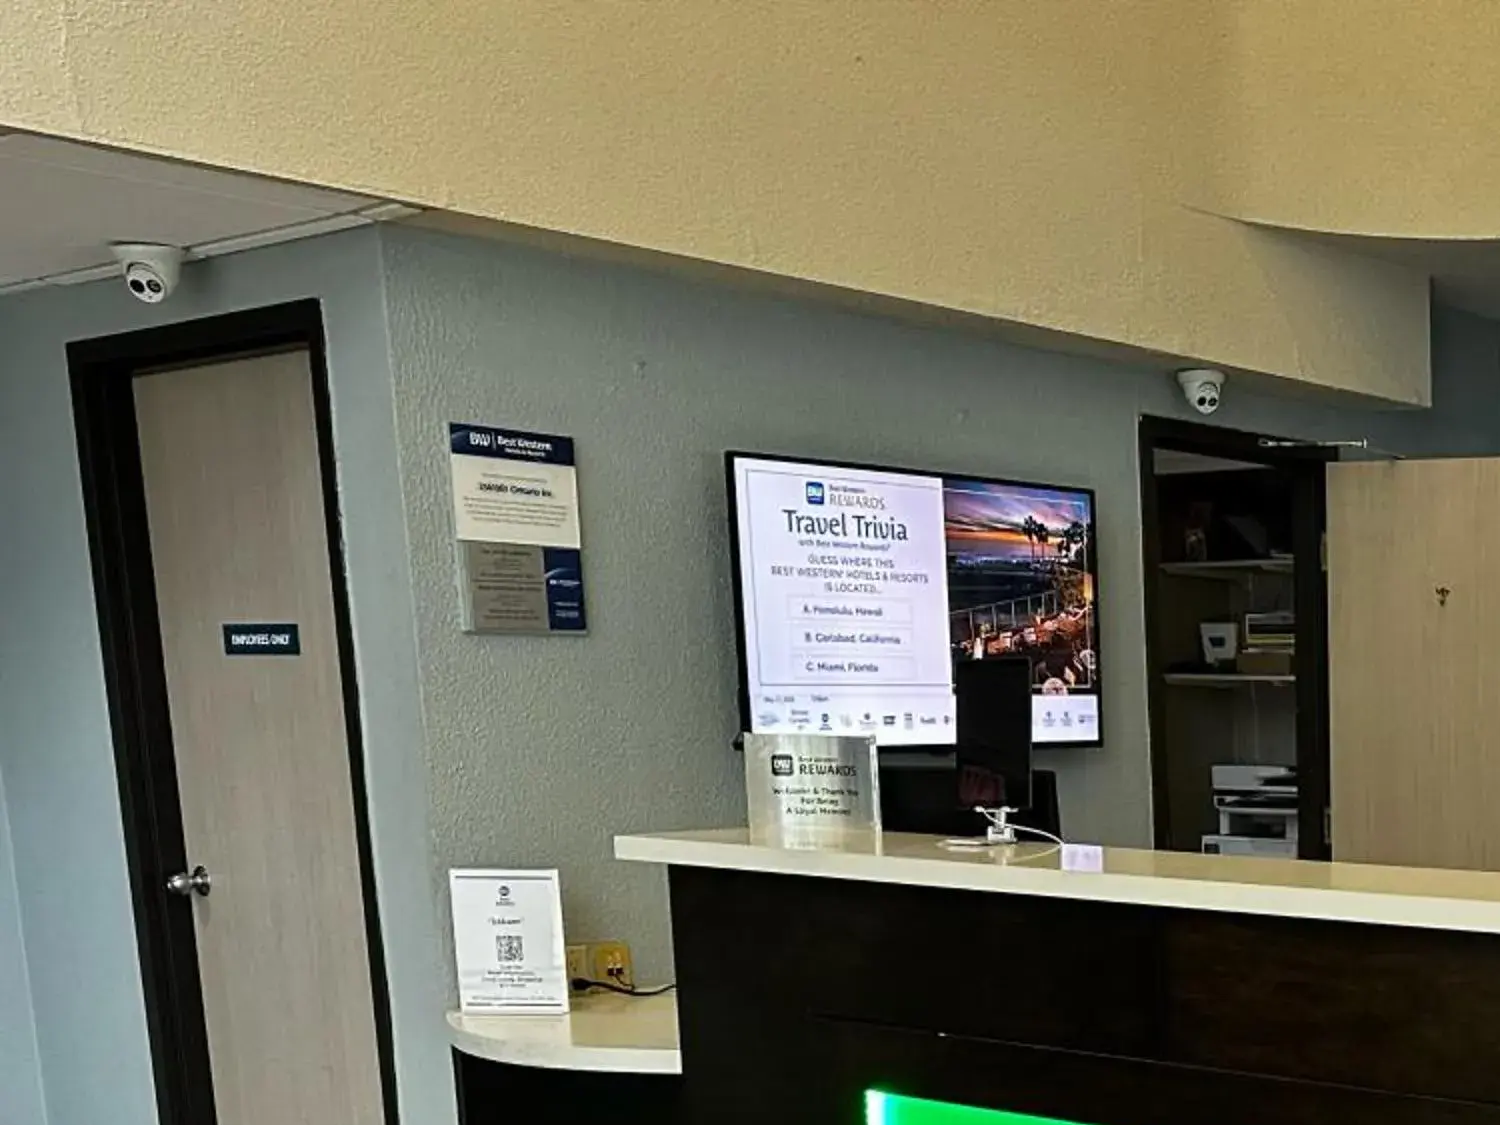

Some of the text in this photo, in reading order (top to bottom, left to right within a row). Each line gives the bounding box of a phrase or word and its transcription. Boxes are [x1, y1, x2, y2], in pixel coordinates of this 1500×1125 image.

[782, 509, 909, 541] Travel Trivia
[875, 558, 895, 569] THIS
[771, 565, 794, 577] BEST
[799, 763, 858, 777] REWARDS
